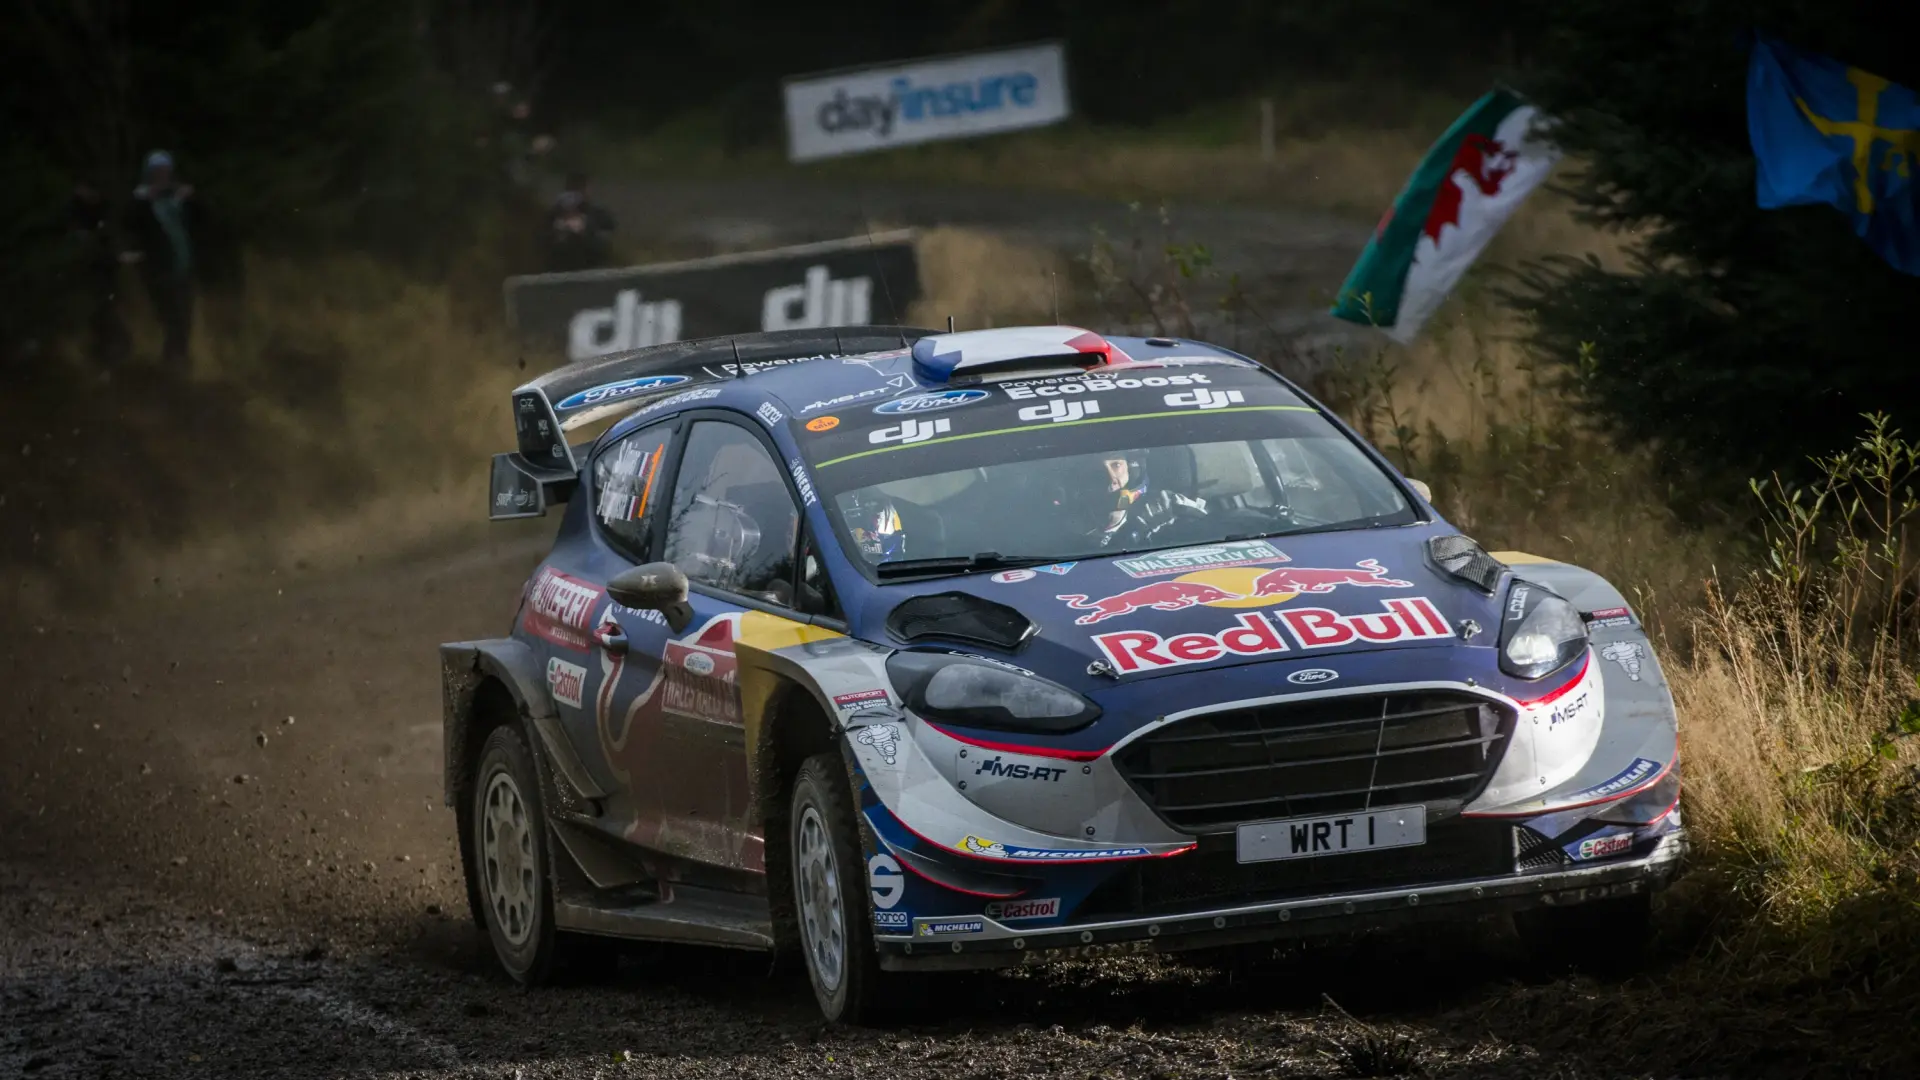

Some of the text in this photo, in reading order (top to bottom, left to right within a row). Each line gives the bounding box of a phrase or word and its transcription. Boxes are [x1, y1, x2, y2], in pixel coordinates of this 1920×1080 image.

[816, 71, 1038, 138] dayinsure
[998, 372, 1119, 389] Powered by
[1003, 373, 1211, 400] EcoBoost
[520, 398, 534, 407] OZ
[758, 401, 783, 424] sparco
[793, 465, 816, 506] ONEBET
[1125, 557, 1193, 572] WALES
[1195, 550, 1243, 564] RALLY
[1246, 546, 1275, 558] GB
[1002, 571, 1026, 581] E
[1092, 597, 1455, 673] Red Bull
[555, 664, 583, 703] Castrol
[841, 690, 882, 700] AUTOSPORT
[990, 759, 1067, 782] MS-RT
[1290, 818, 1353, 854] WRT
[1013, 848, 1142, 858] MICHELIN
[1004, 899, 1055, 918] Castrol
[934, 922, 982, 932] MICHELIN
